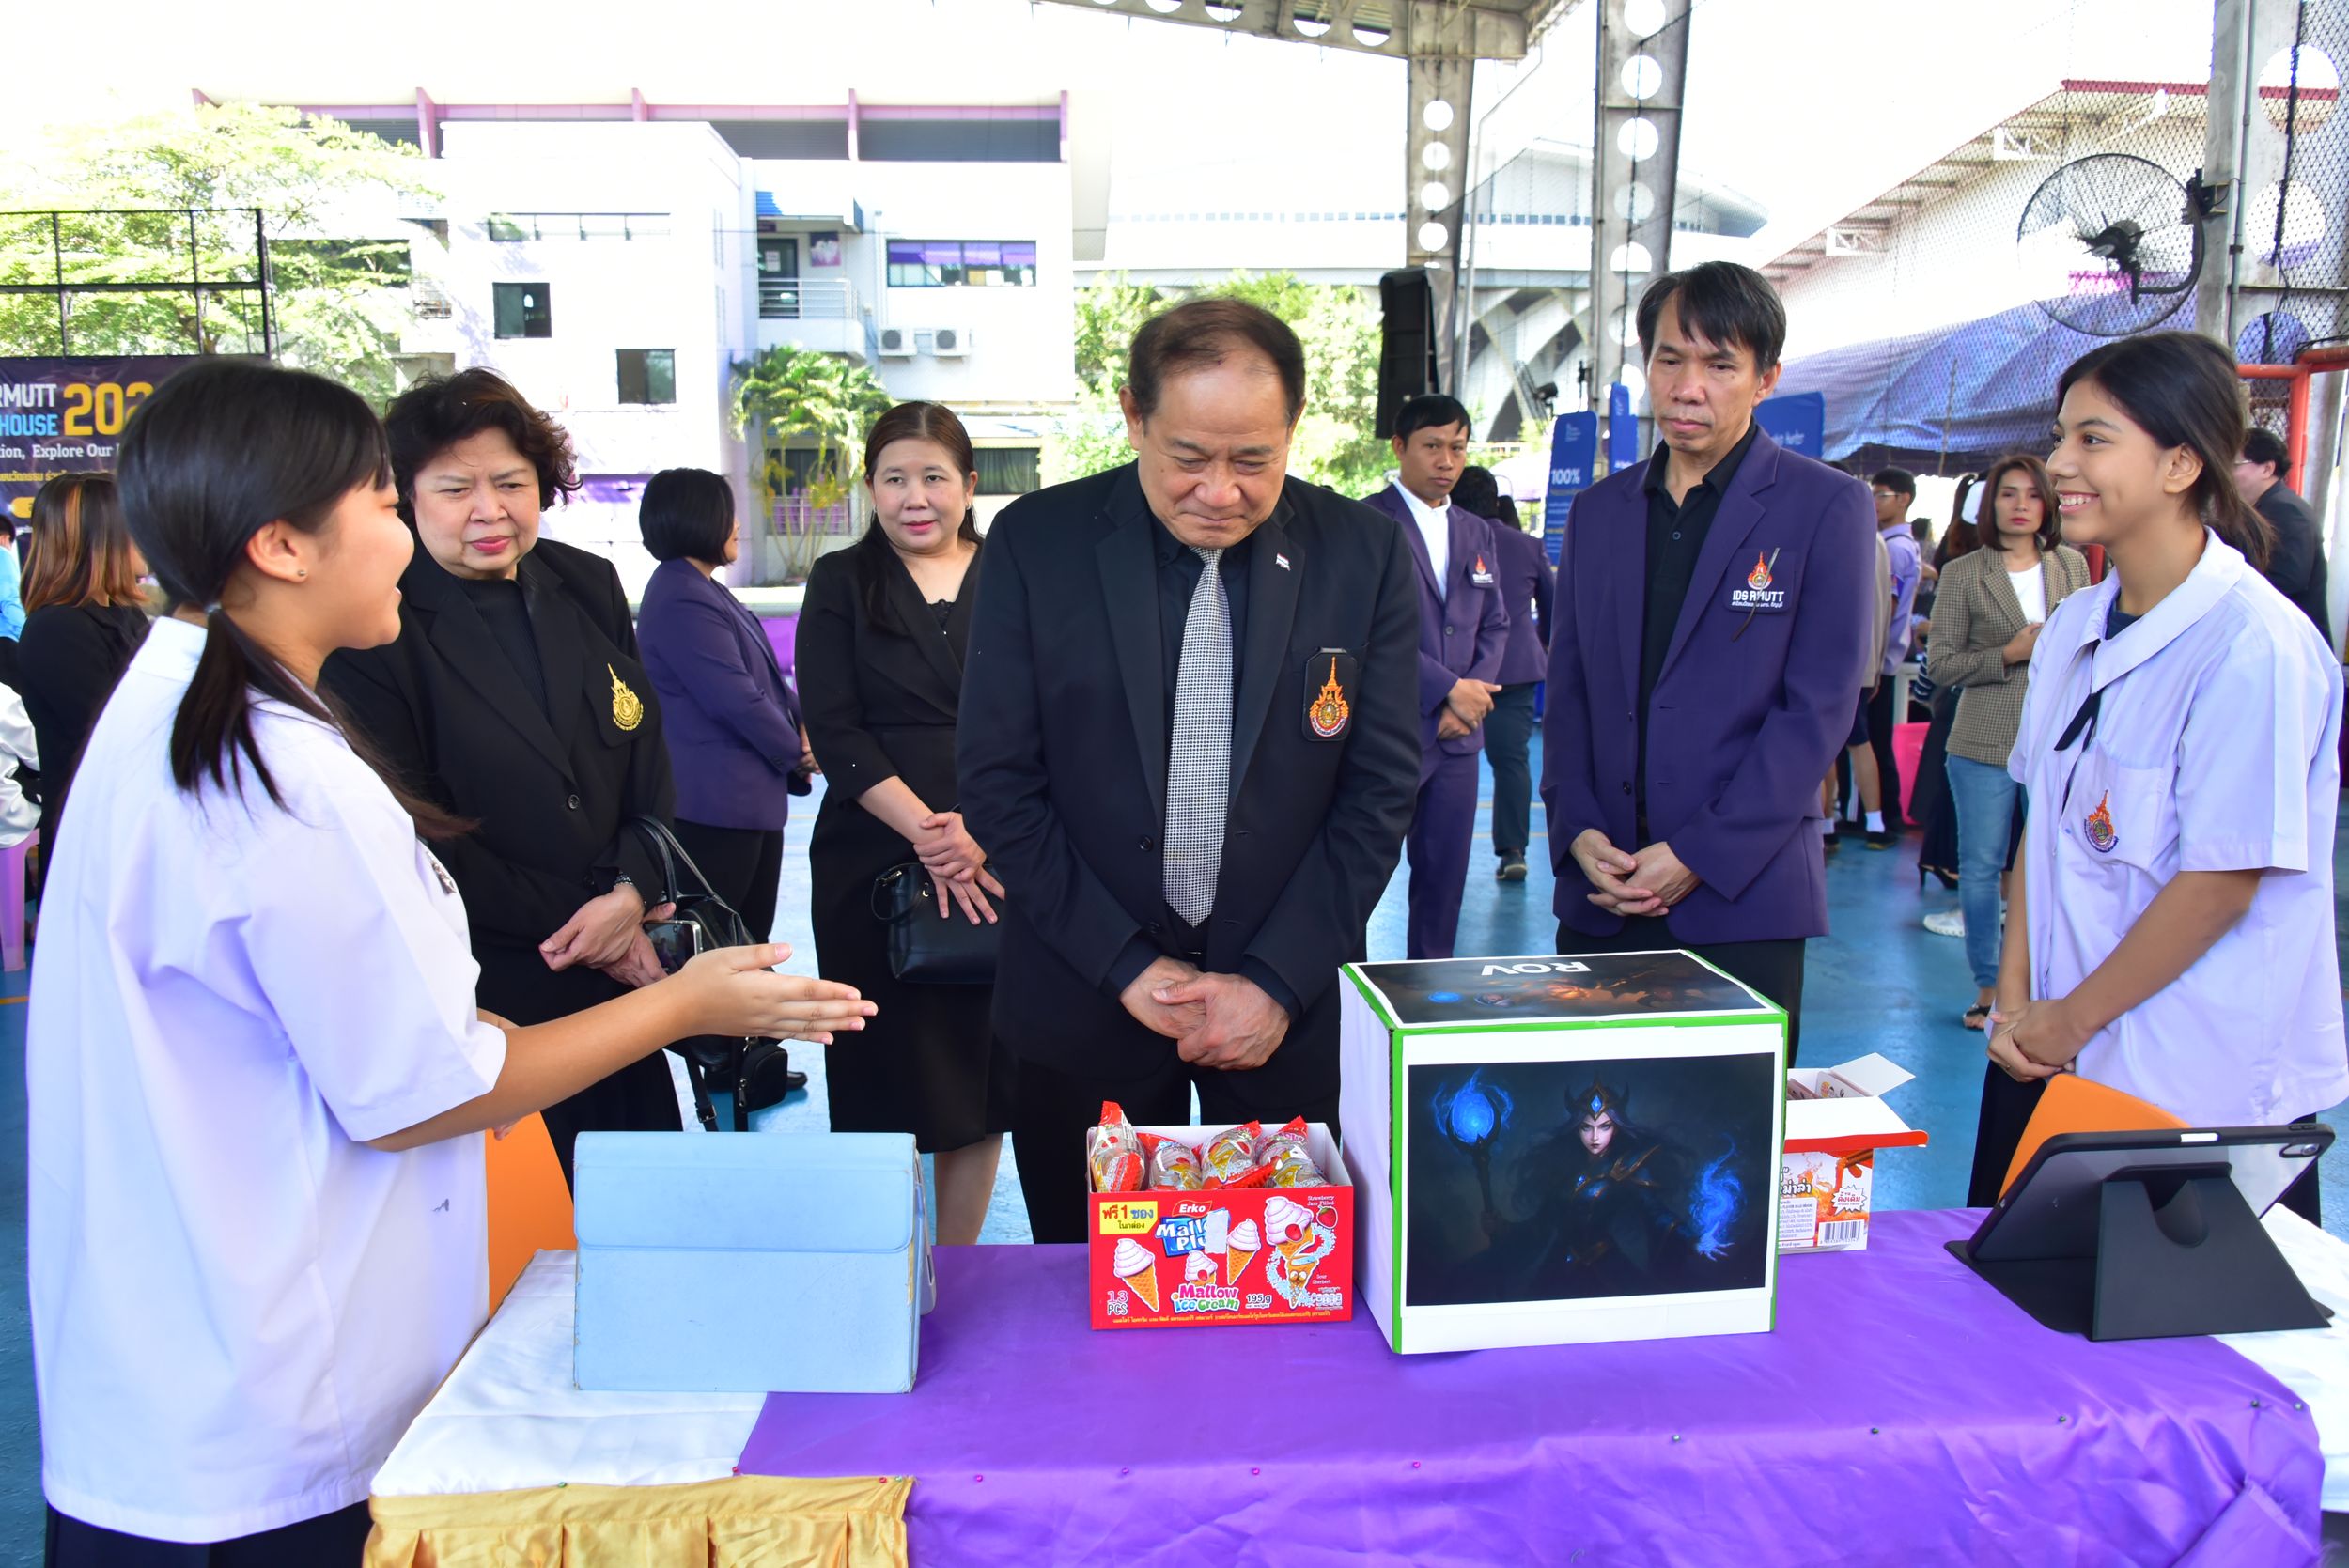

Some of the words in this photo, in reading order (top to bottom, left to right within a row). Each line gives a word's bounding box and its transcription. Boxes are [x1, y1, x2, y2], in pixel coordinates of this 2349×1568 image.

[63, 382, 154, 436] 202
[0, 413, 58, 437] HOUSE
[32, 444, 84, 460] Explore
[87, 444, 114, 458] Our
[1550, 468, 1580, 485] 100%
[1732, 589, 1749, 601] IDS
[1750, 590, 1784, 602] RMUTT
[1481, 961, 1593, 976] ROV
[1102, 1204, 1119, 1219] ฟรี
[1121, 1204, 1128, 1219] 1
[1178, 1203, 1206, 1214] Erko
[1107, 1291, 1128, 1303] 13
[1178, 1284, 1239, 1299] Mallow
[1247, 1294, 1264, 1303] 195
[1107, 1302, 1128, 1316] PCS
